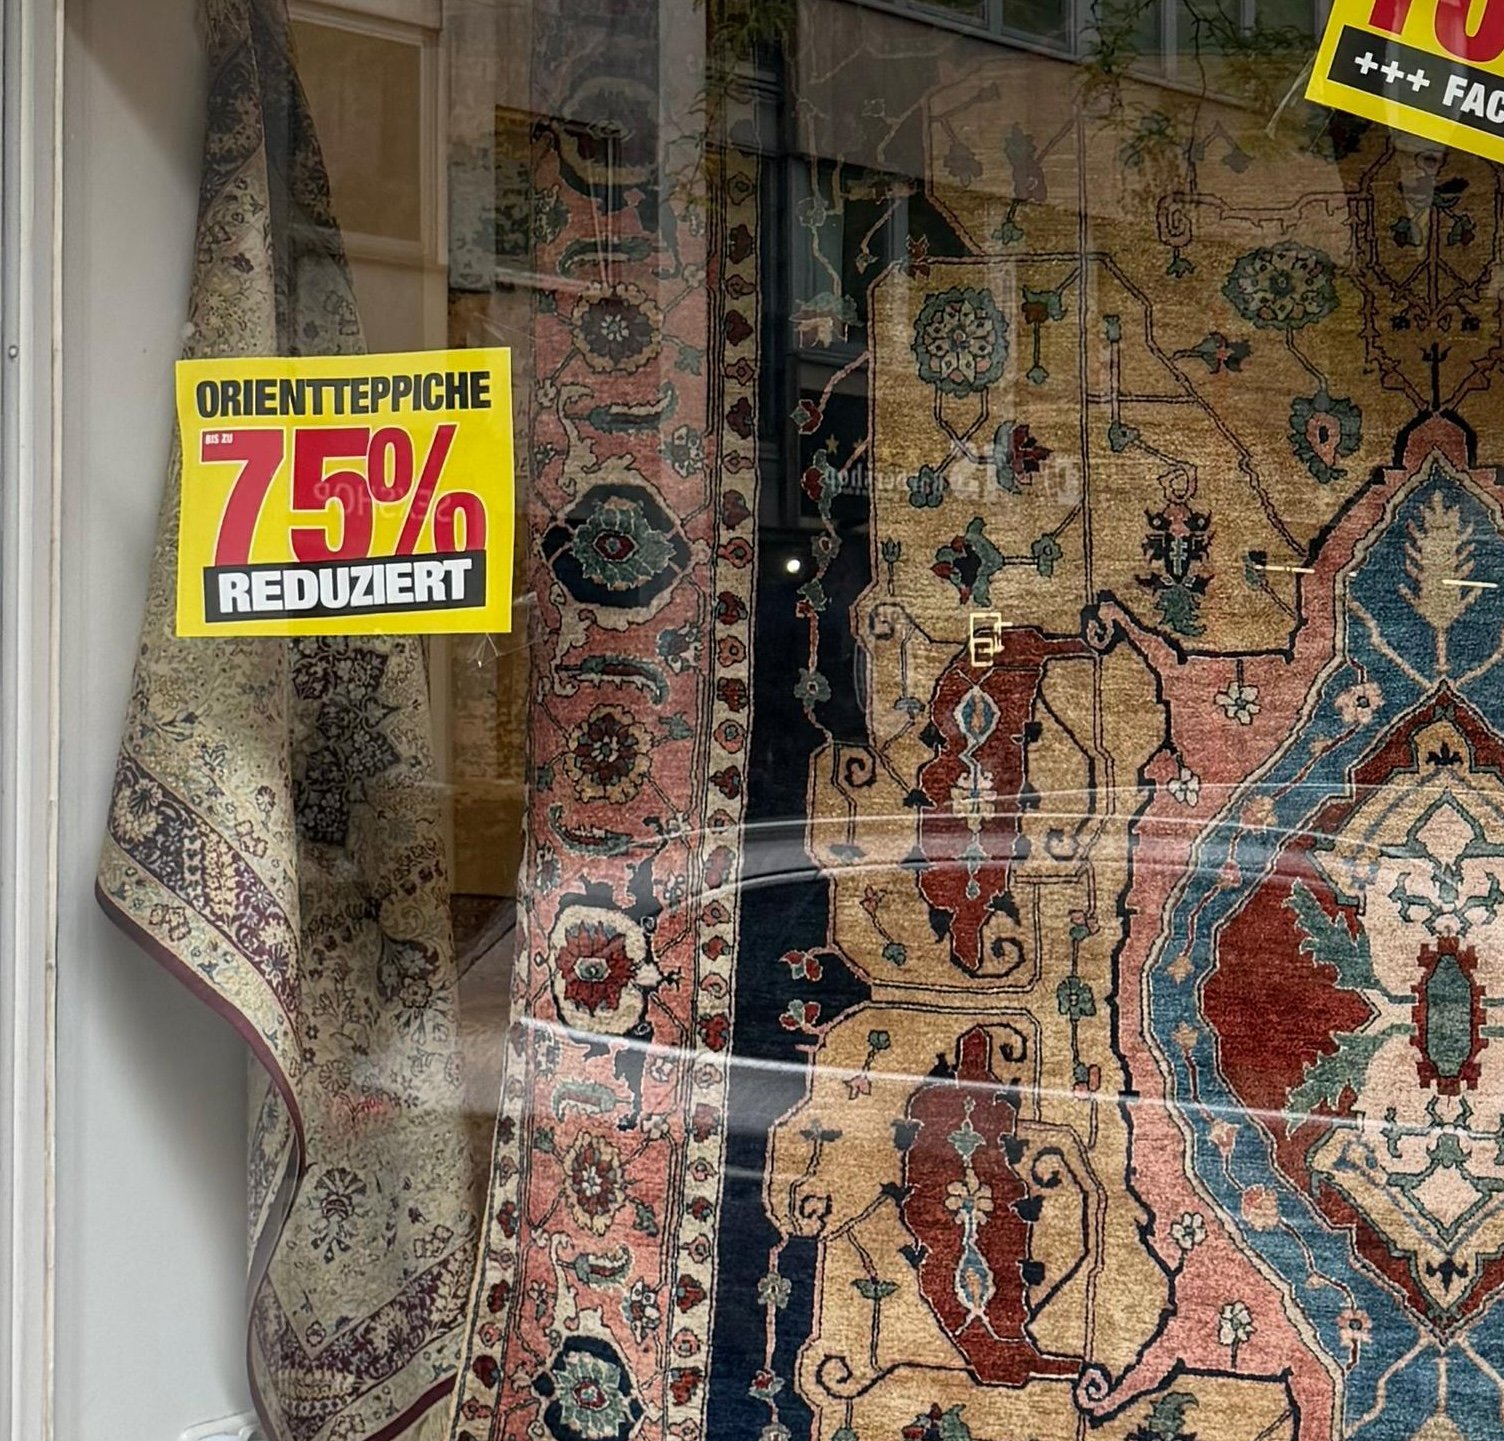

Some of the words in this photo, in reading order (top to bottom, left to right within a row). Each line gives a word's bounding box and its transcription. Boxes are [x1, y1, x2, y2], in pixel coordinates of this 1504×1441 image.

[196, 370, 492, 418] ORIENTTEPPICHE
[220, 432, 234, 444] ZU
[201, 423, 487, 567] 75%
[218, 558, 473, 614] REDUZIERT
